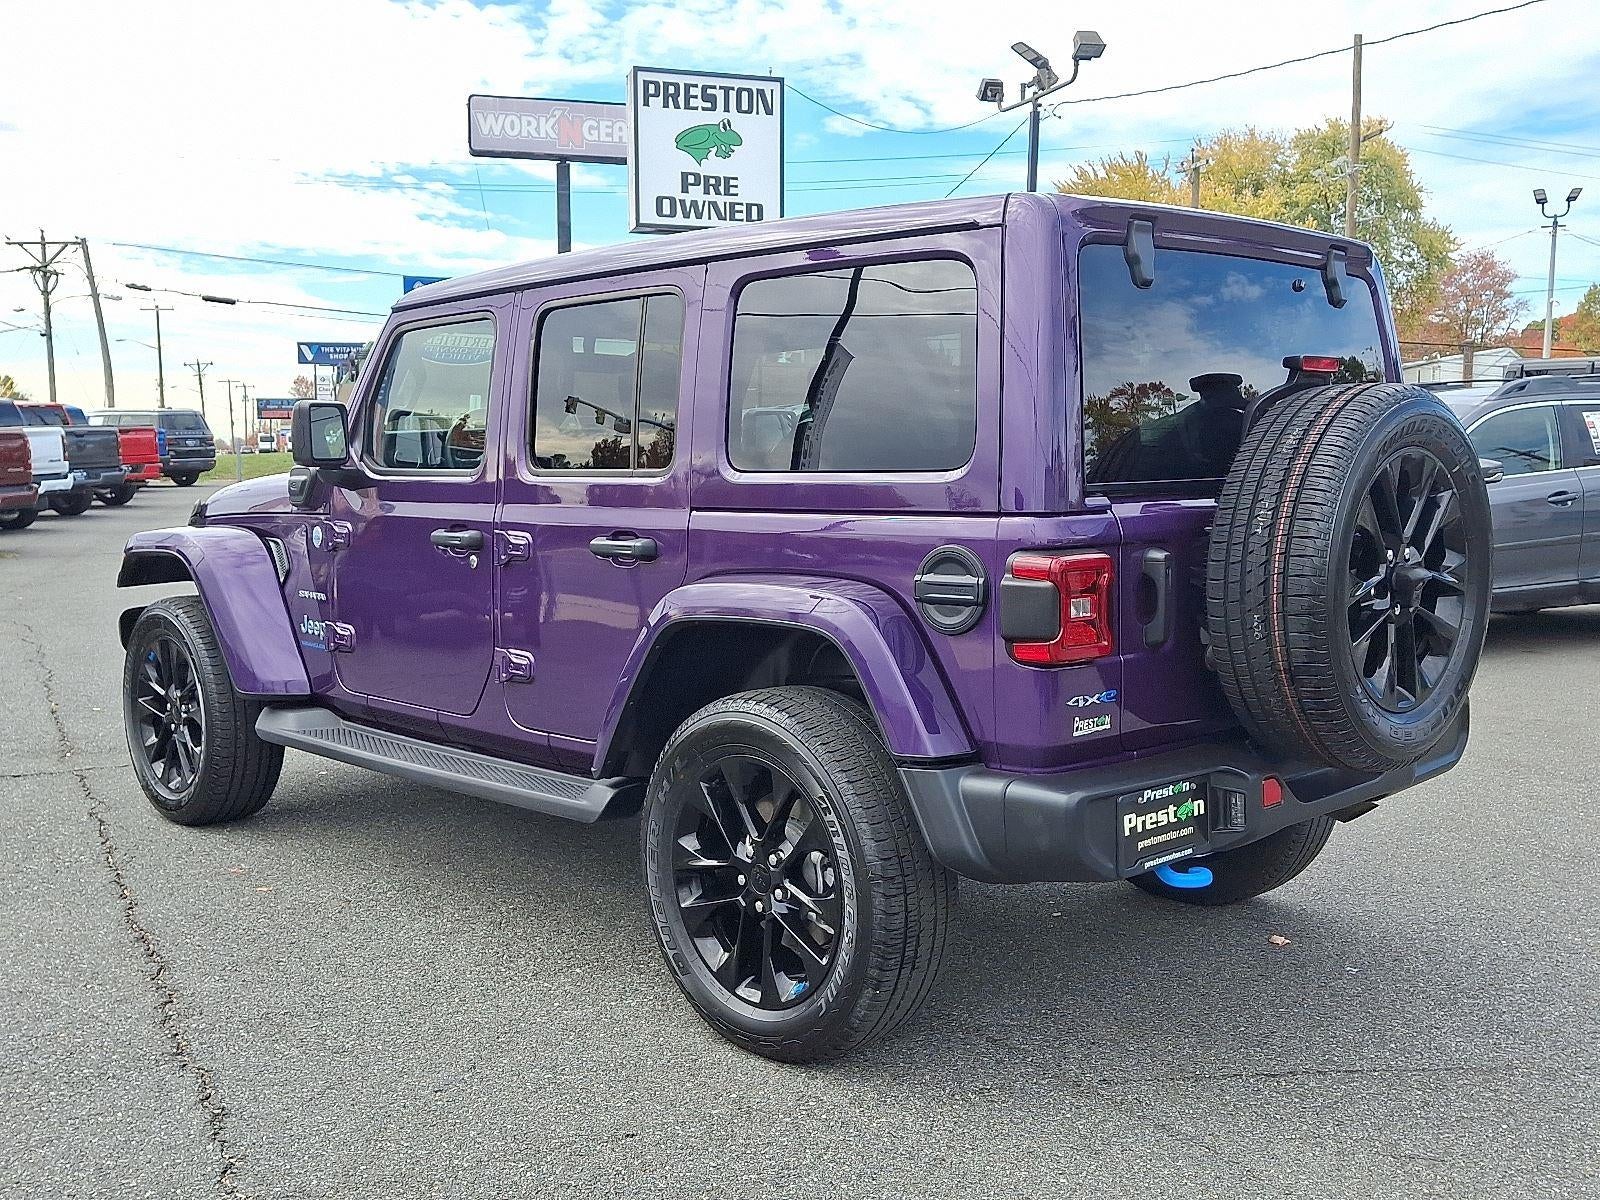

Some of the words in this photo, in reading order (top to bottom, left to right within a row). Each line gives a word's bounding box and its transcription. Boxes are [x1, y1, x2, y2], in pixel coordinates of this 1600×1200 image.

[642, 79, 774, 116] PRESTON
[474, 110, 558, 140] WORK
[582, 116, 628, 145] GEA
[680, 171, 739, 197] PRE
[655, 195, 764, 222] OWNED
[299, 614, 326, 641] Jeep
[1065, 688, 1118, 708] 4xe
[1137, 826, 1194, 852] prestonmotor.com
[649, 817, 692, 978] DUELER
[813, 793, 855, 1017] BRIDGESTONE
